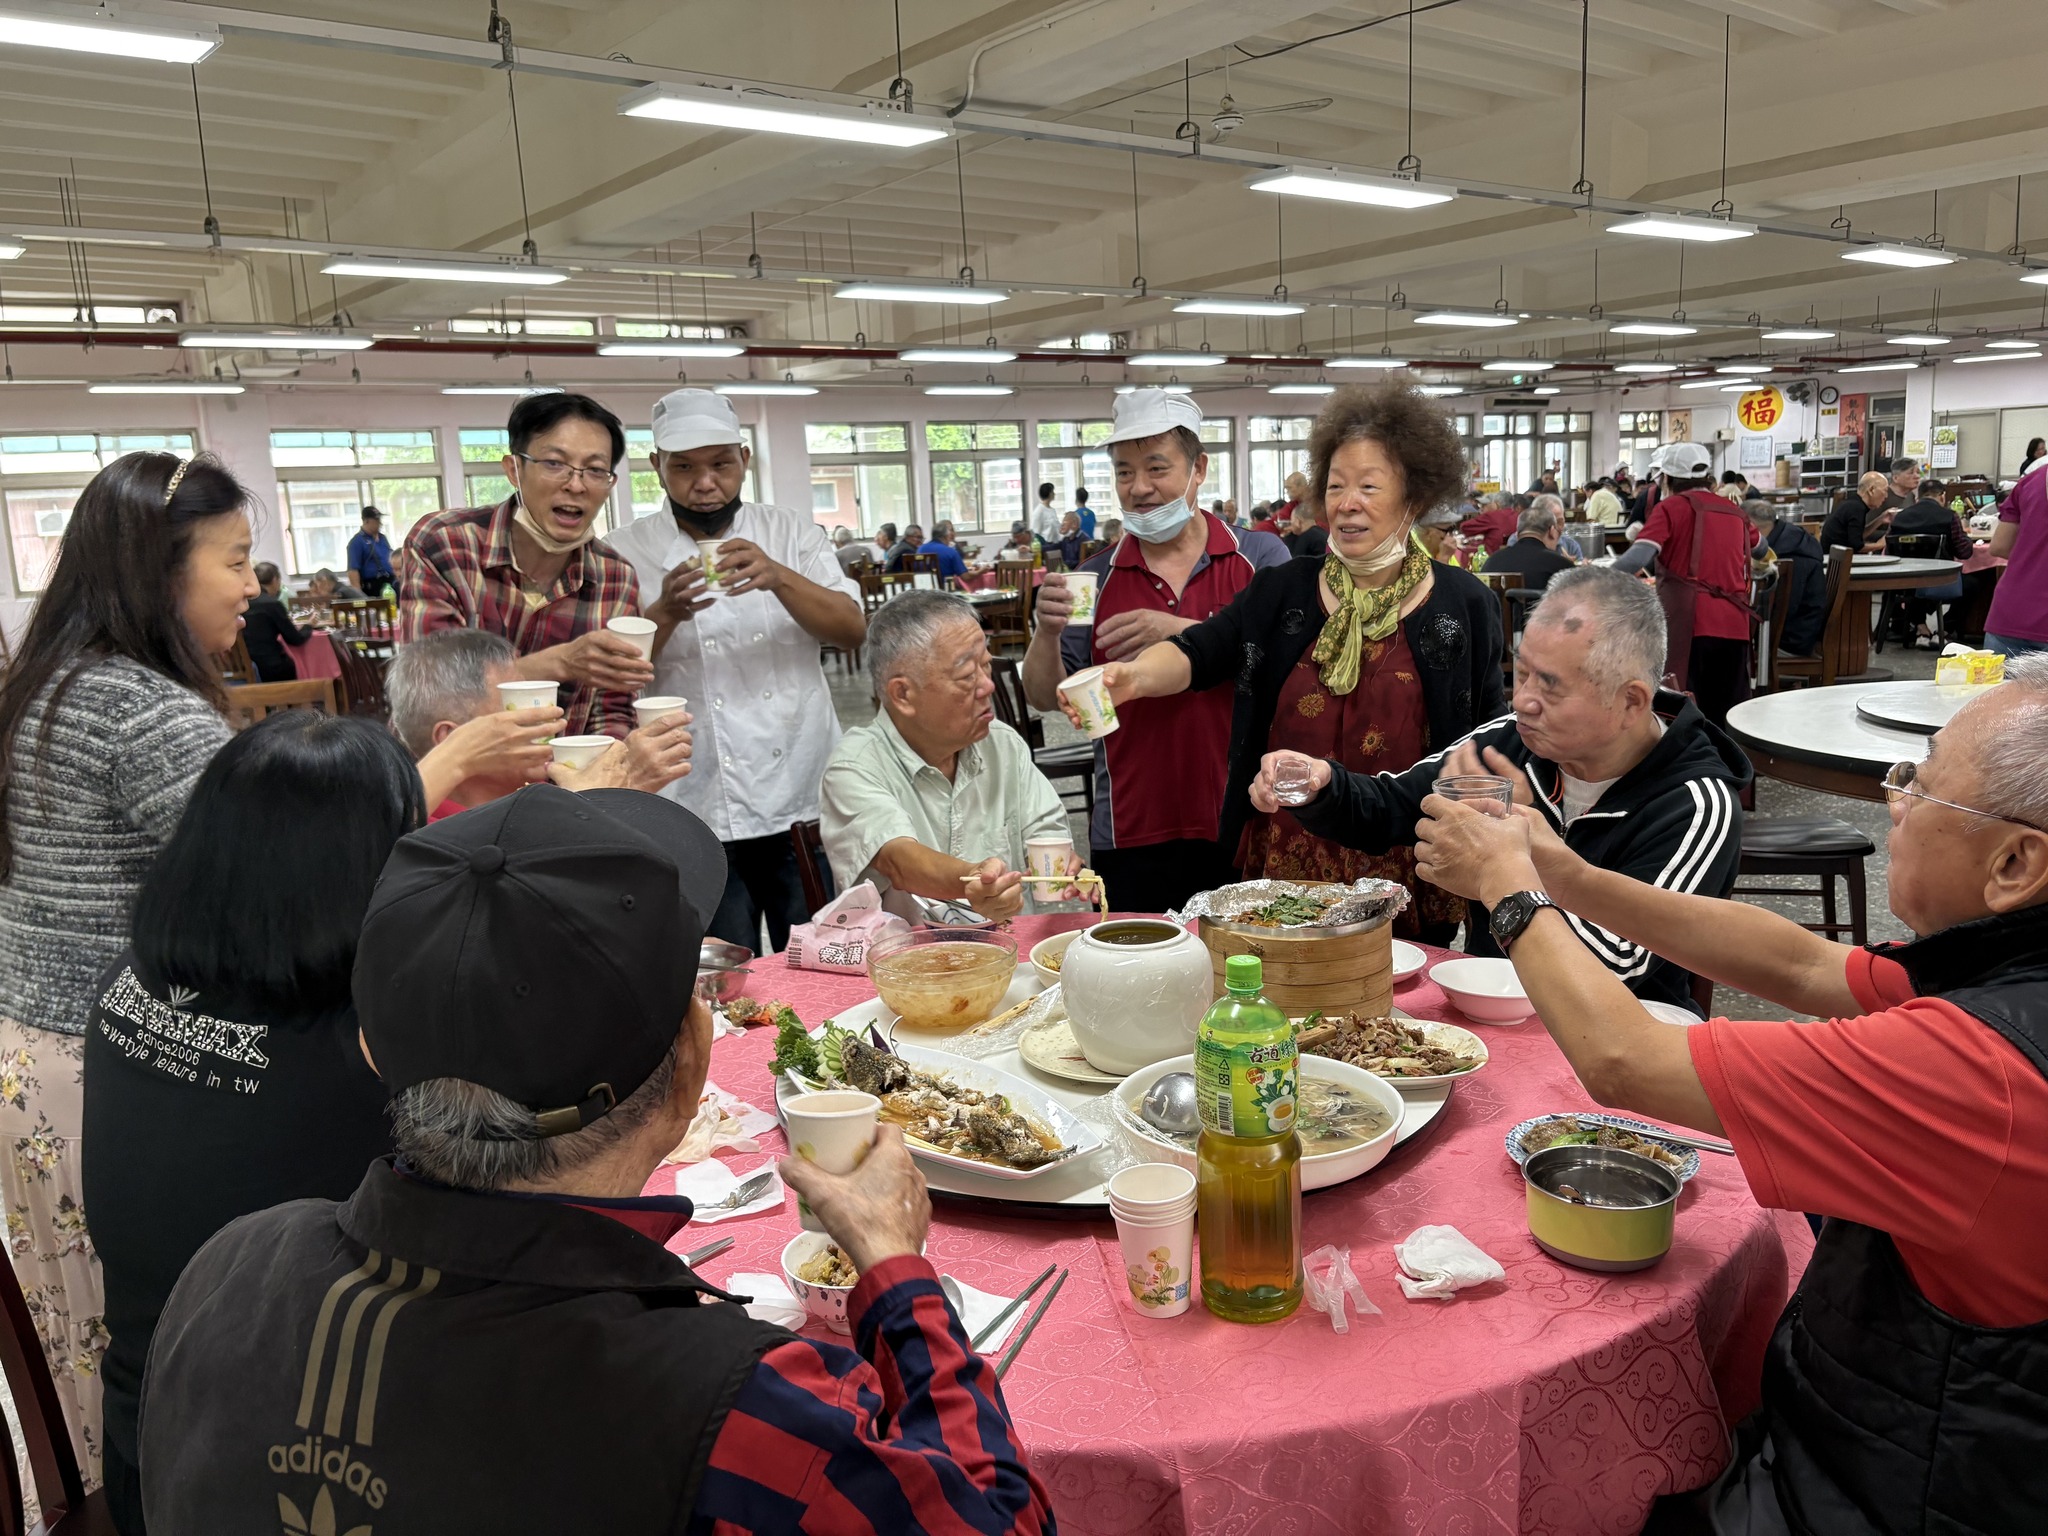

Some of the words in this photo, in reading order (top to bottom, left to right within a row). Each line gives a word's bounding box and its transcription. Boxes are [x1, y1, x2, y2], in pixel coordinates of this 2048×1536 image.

[1742, 389, 1777, 426] 福
[206, 1069, 222, 1088] in
[267, 1435, 388, 1510] adidas
